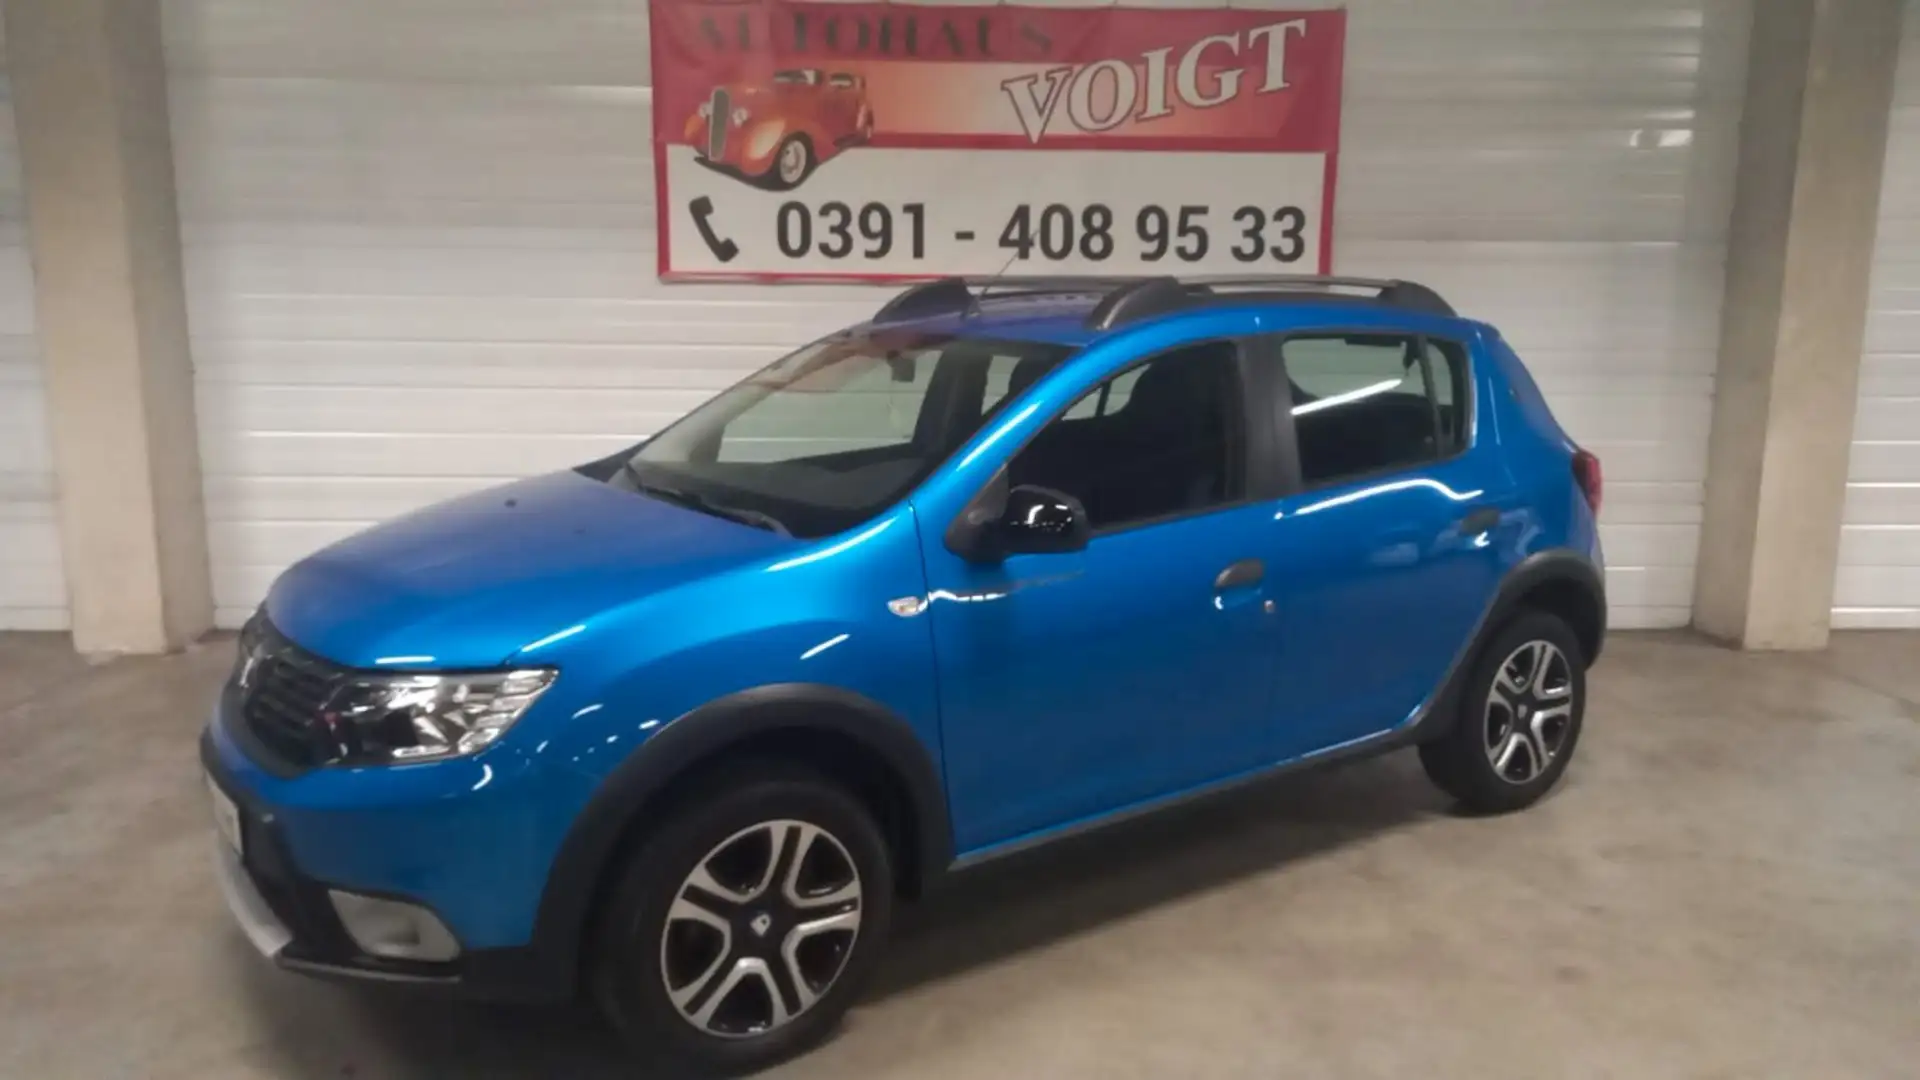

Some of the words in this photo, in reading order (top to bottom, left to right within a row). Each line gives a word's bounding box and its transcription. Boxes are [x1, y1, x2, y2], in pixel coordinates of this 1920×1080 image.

[1001, 19, 1306, 144] VOIGT
[776, 200, 925, 260] 0391
[998, 204, 1114, 263] 408
[1135, 205, 1209, 262] 95
[1230, 205, 1306, 263] 33
